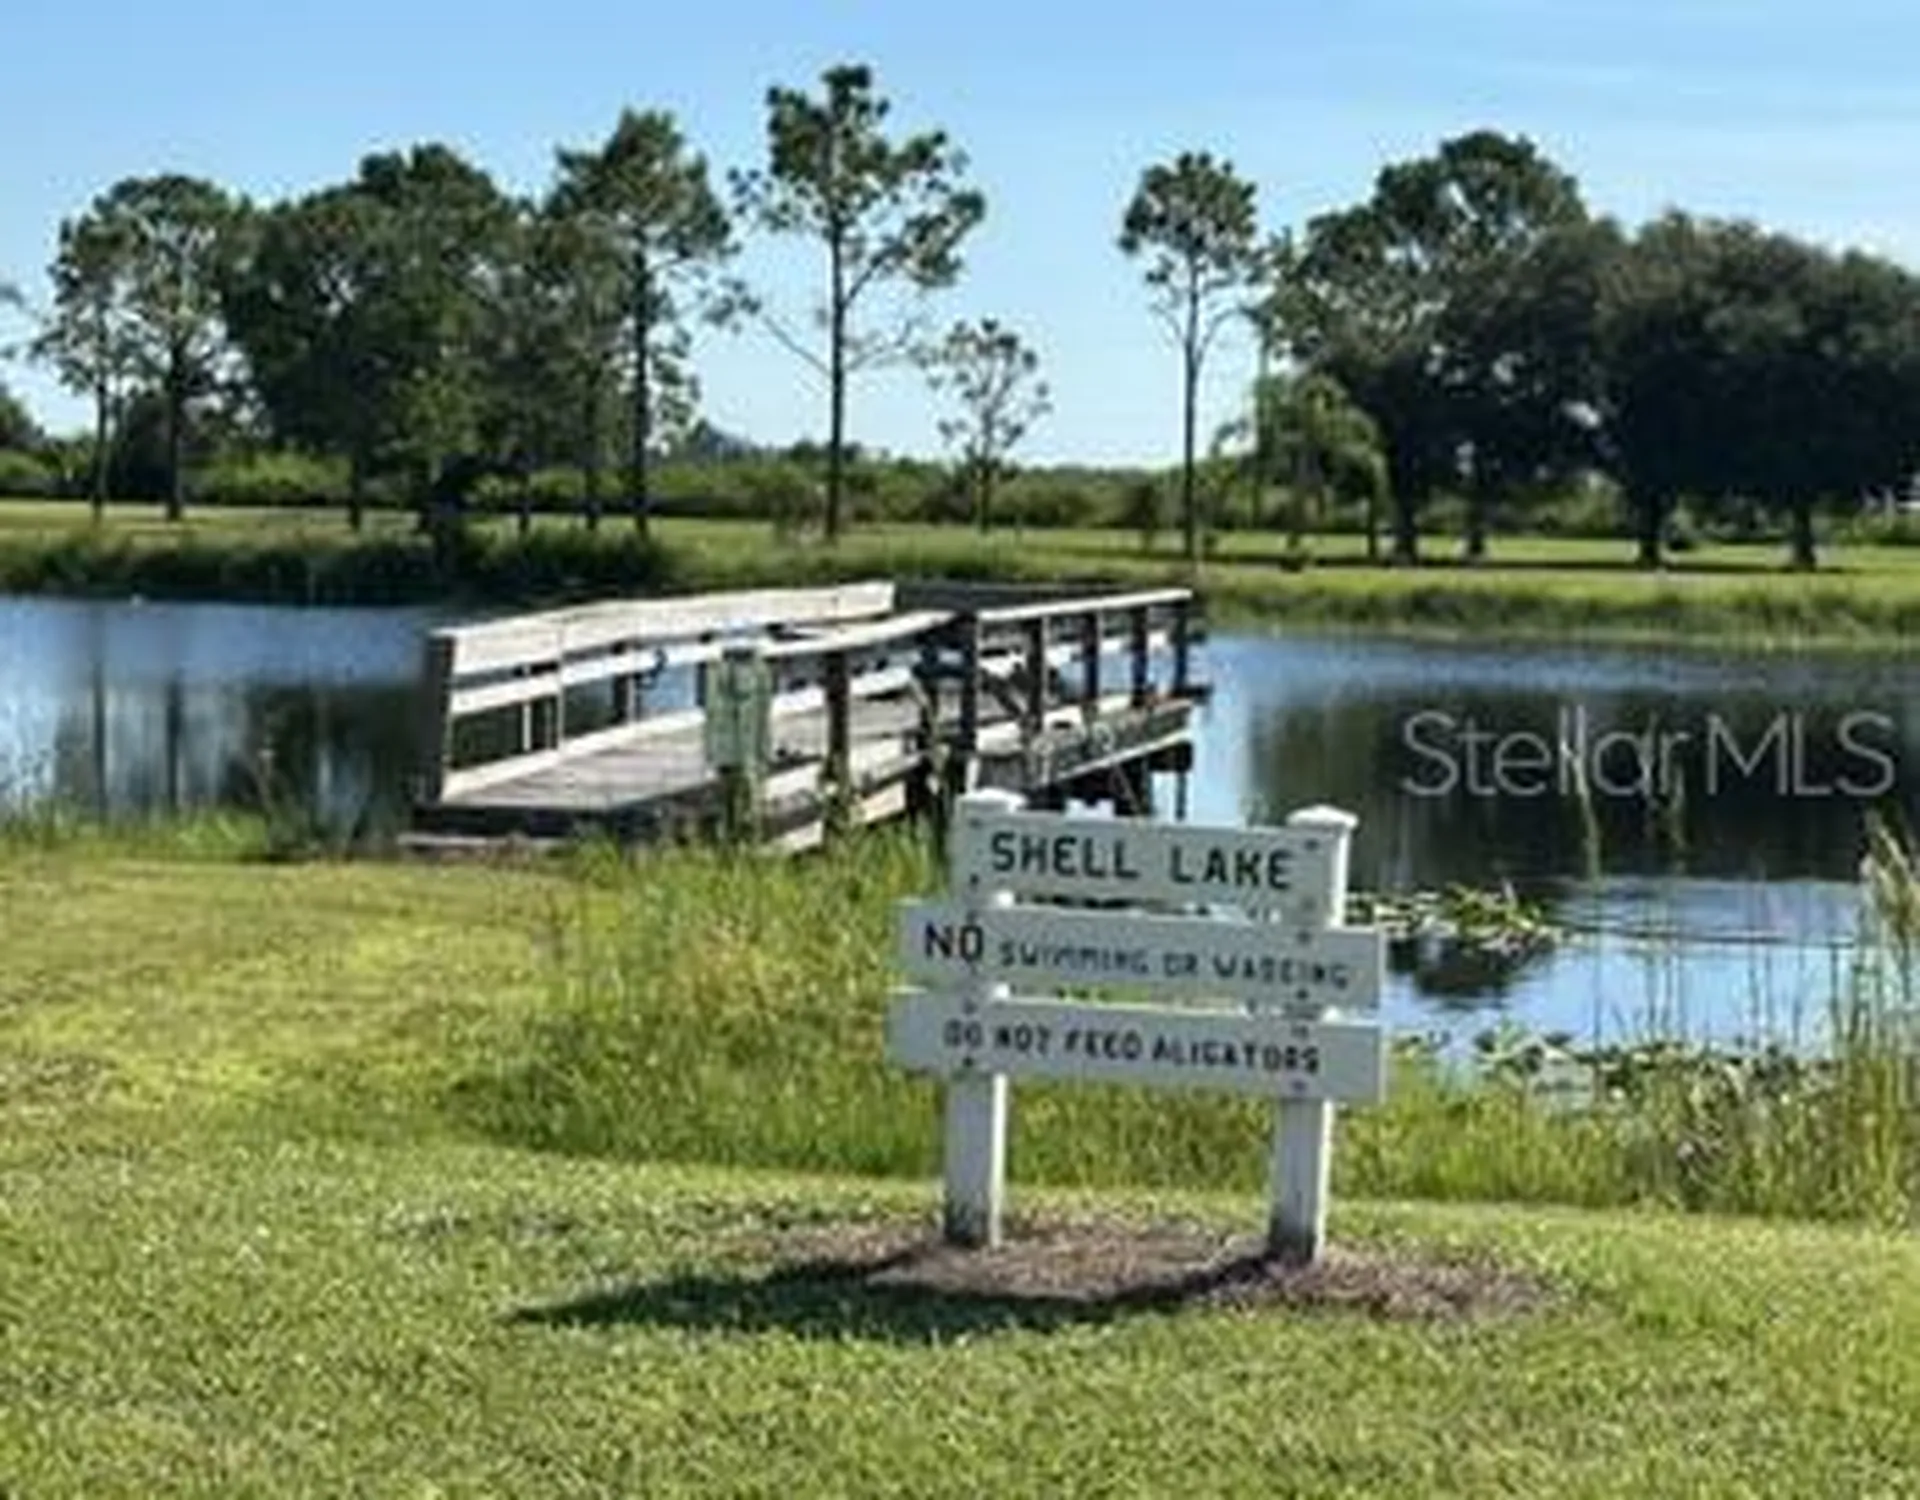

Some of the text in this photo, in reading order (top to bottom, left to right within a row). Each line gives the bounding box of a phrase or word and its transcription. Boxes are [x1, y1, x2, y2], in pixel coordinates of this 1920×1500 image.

[990, 831, 1294, 891] SHELL LAKE
[924, 924, 985, 962] NO
[999, 940, 1149, 975] SWIMMING
[1163, 952, 1198, 977] OR
[943, 1018, 982, 1048] DO
[995, 1024, 1050, 1056] NOT
[1064, 1029, 1143, 1061] FEED
